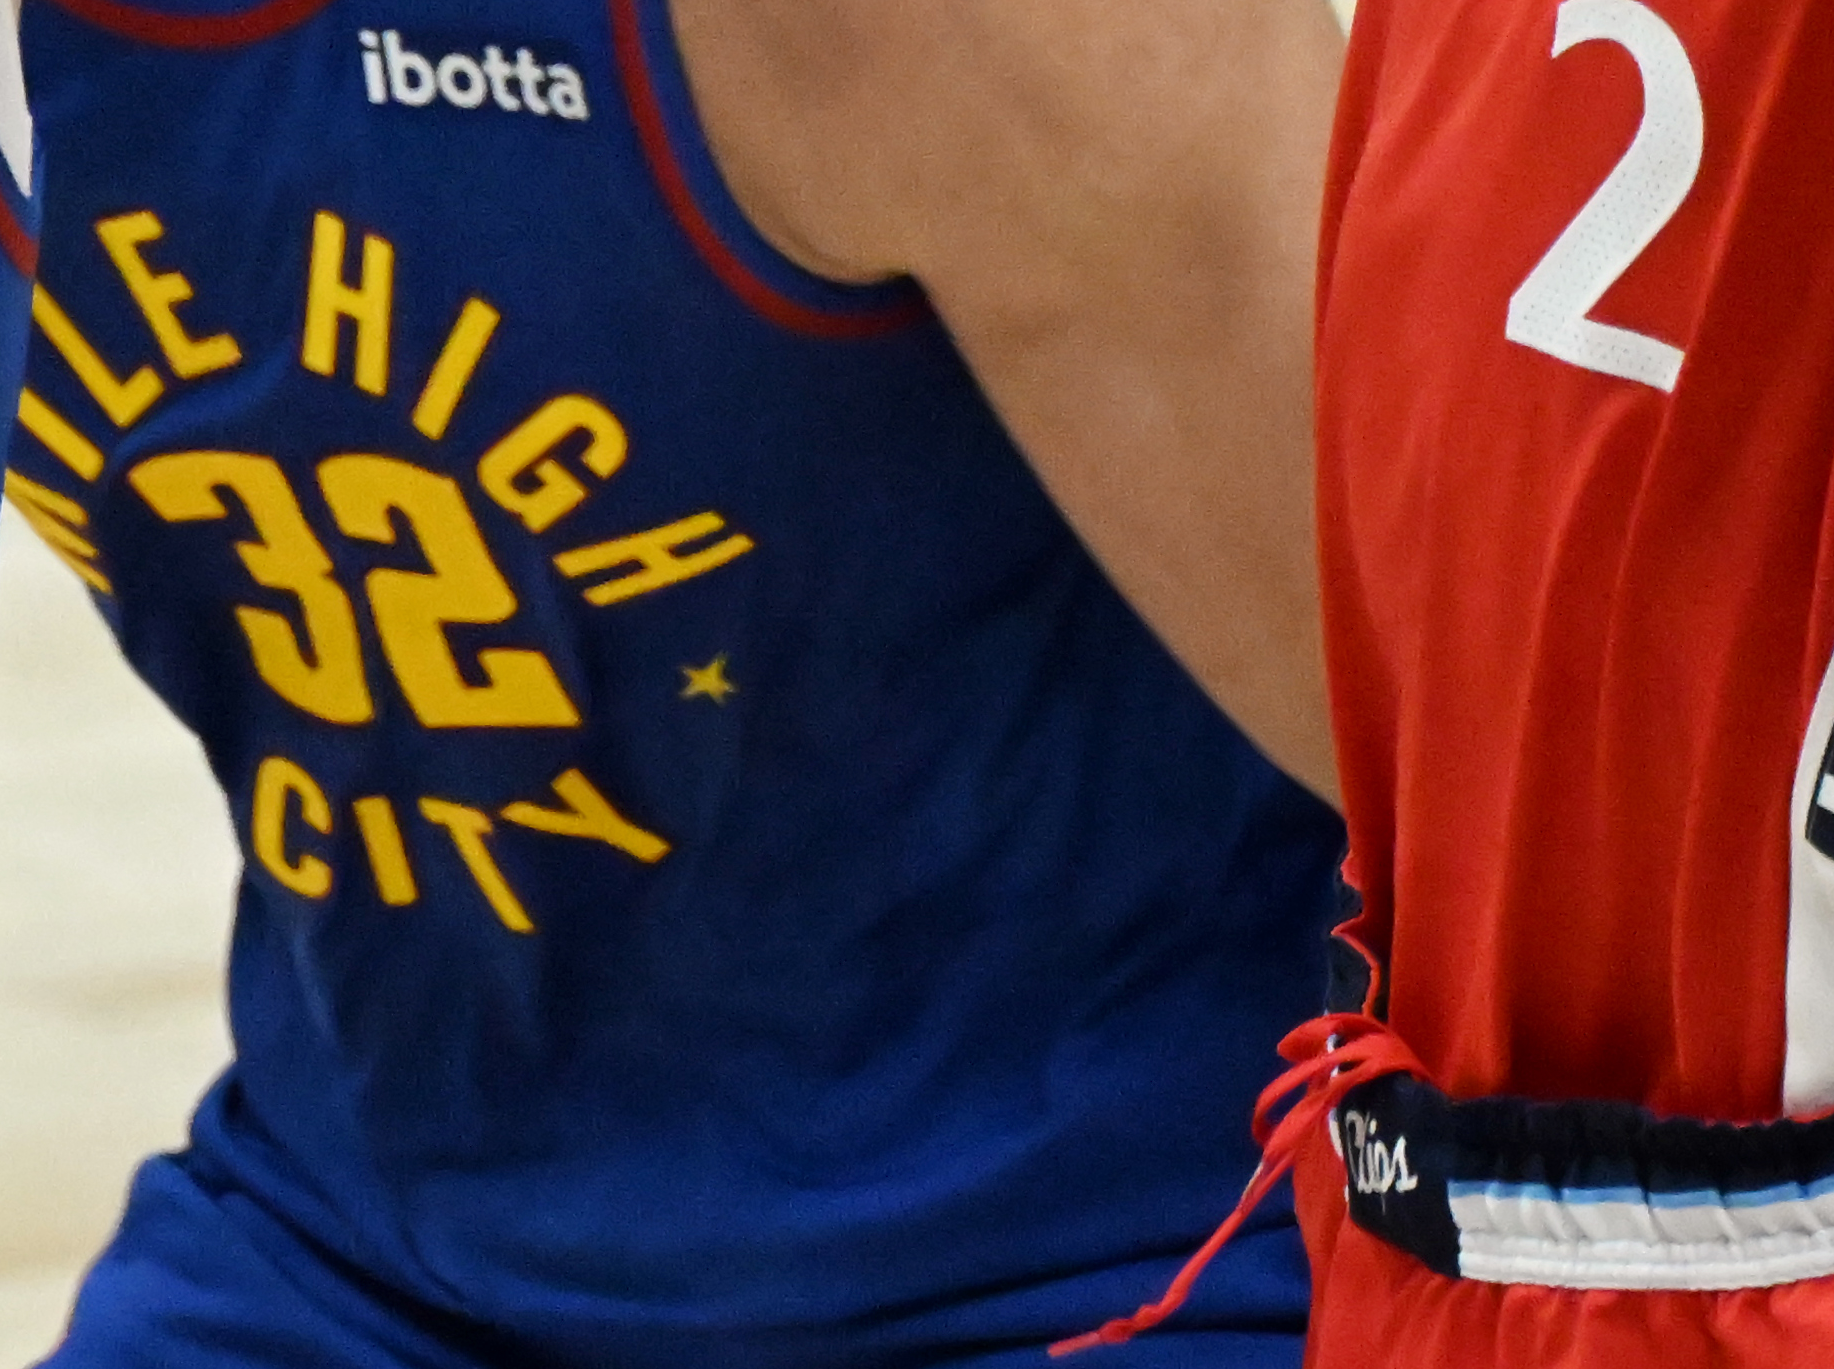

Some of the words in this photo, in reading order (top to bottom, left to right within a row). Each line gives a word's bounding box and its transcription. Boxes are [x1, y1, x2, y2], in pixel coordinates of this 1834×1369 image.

[359, 29, 588, 121] ibotta
[300, 209, 754, 606] HIGH
[129, 450, 580, 728] 32
[252, 757, 669, 933] CITY
